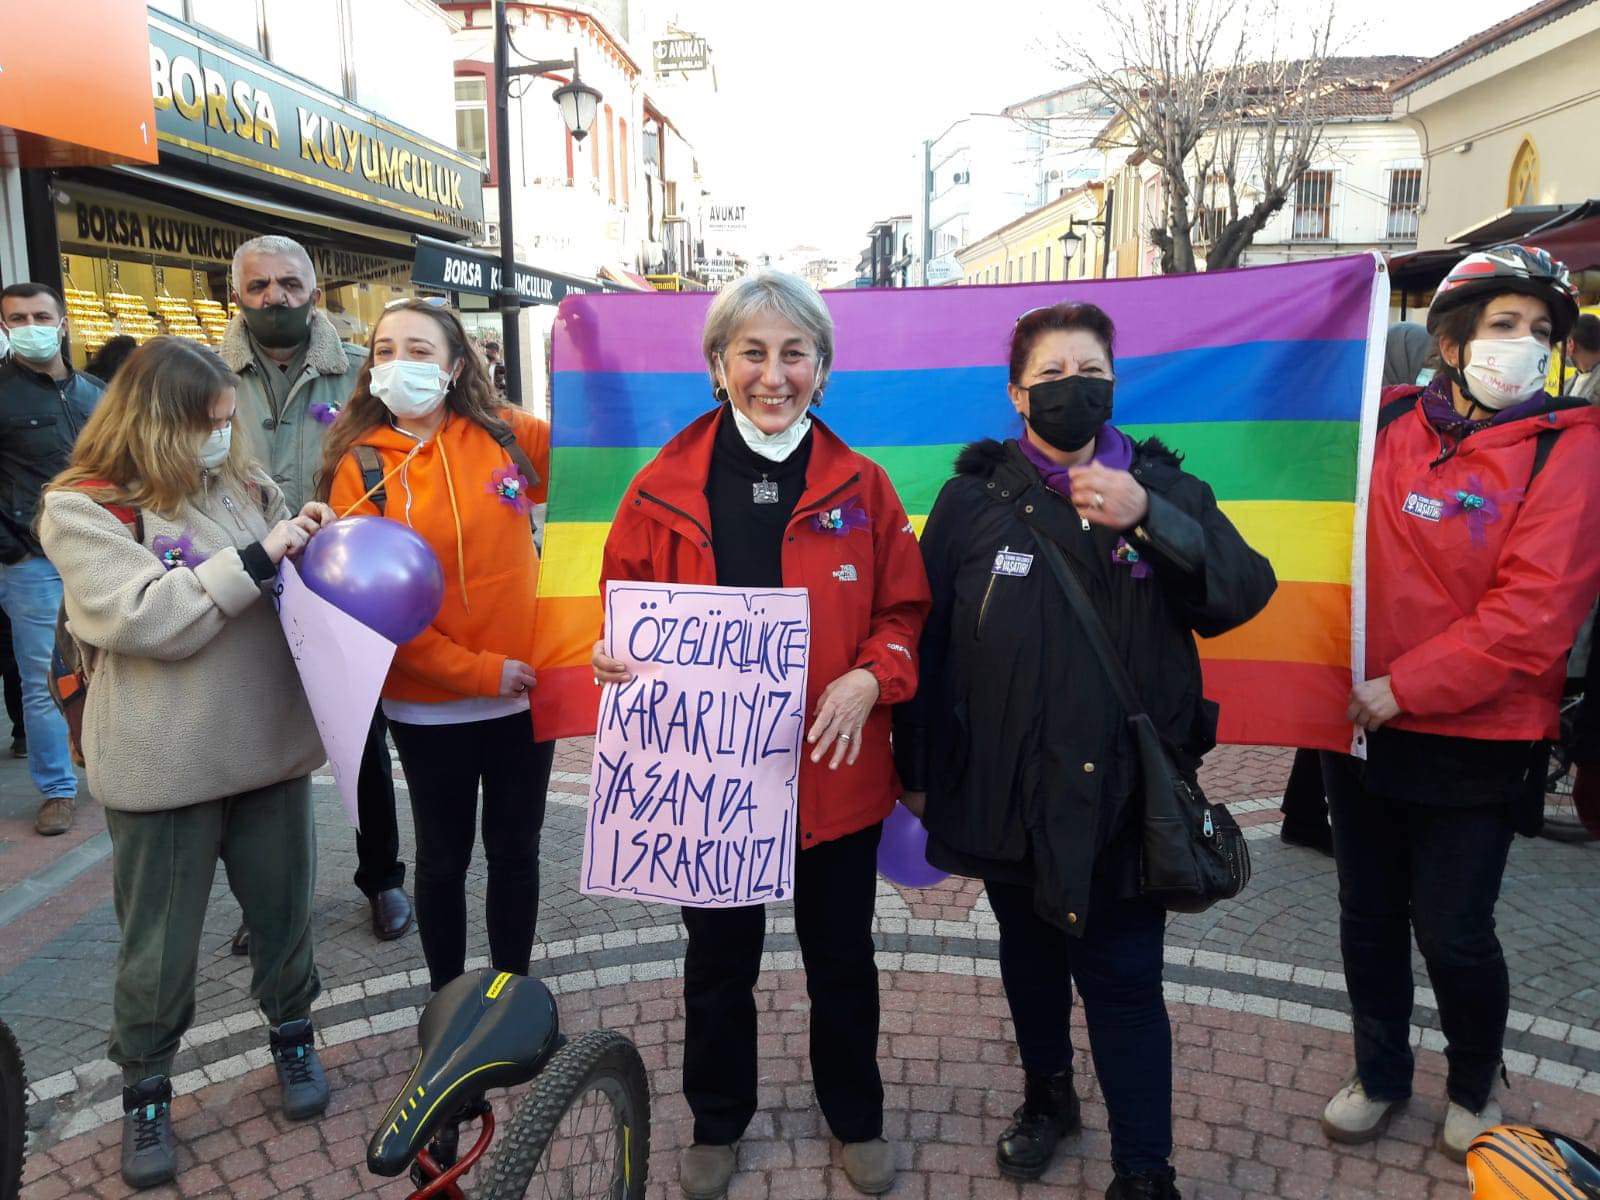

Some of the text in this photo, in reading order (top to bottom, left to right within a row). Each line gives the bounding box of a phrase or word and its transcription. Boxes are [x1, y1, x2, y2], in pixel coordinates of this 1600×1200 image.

[669, 40, 705, 57] AVUKAT
[149, 42, 464, 210] BORSA KUYUMCULUK
[76, 203, 145, 248] BORSA
[147, 216, 256, 260] KUYUMCUL
[709, 205, 745, 221] AVUKAT
[443, 257, 482, 288] BORSA
[628, 601, 808, 684] ÖZGÜRLÜKTE
[608, 675, 792, 768] KARARLIYIZ
